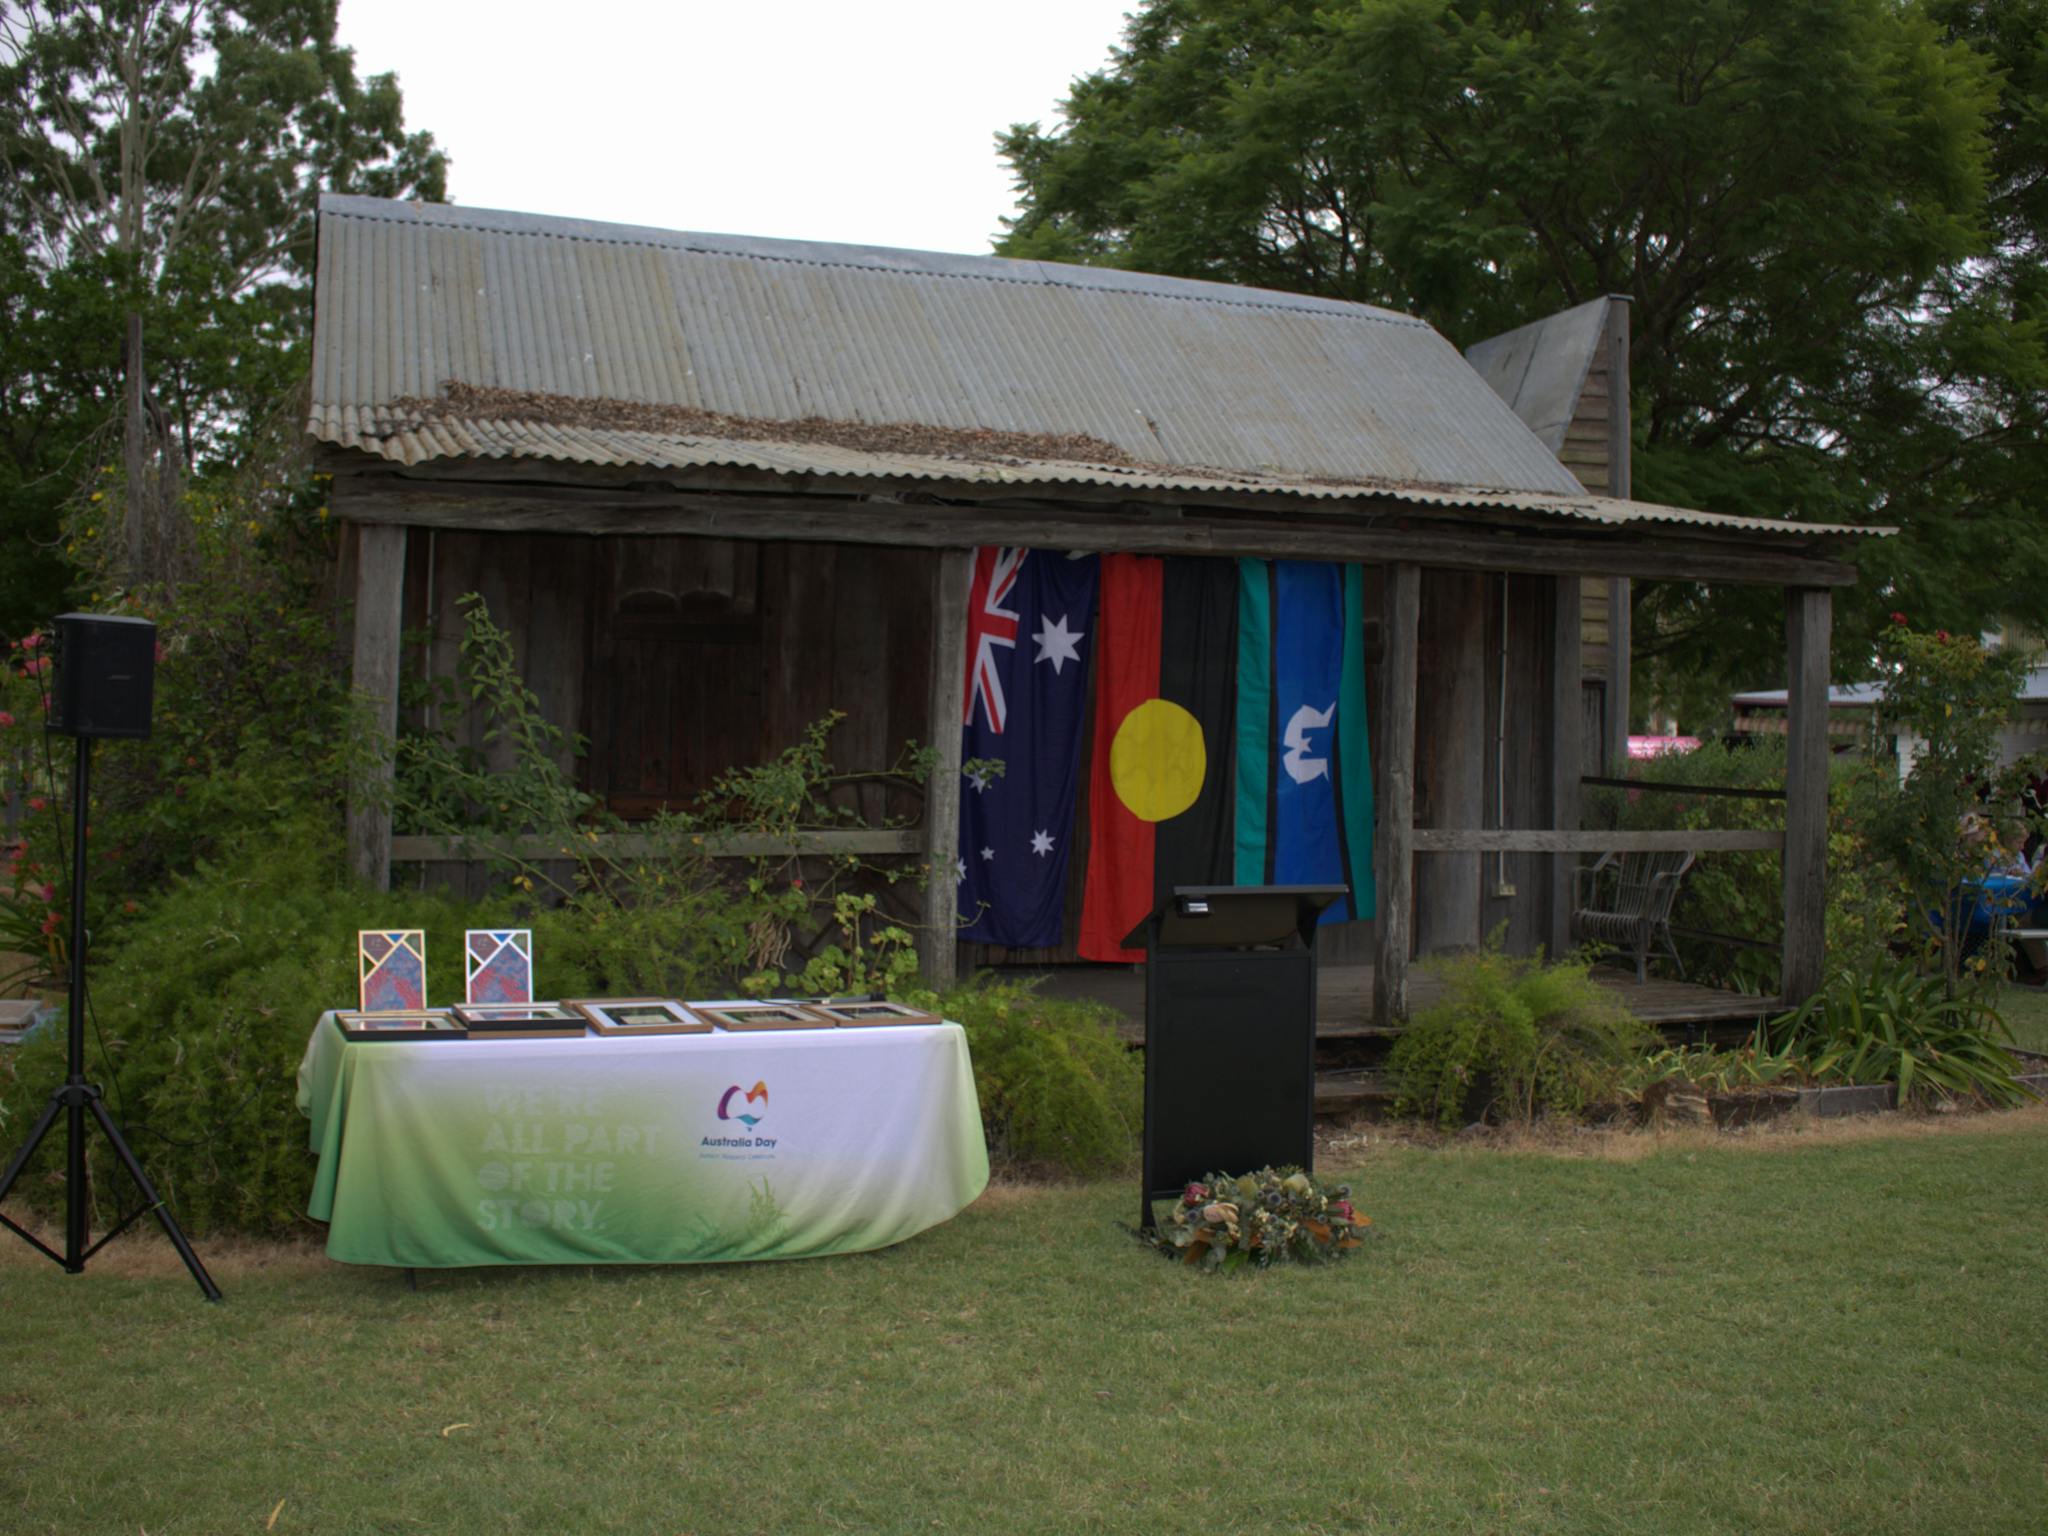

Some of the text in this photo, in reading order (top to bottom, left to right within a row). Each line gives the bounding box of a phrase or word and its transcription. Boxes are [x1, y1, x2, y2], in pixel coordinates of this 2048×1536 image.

[481, 1121, 660, 1154] ALL PART
[701, 1136, 777, 1149] Australia Day
[543, 1161, 616, 1193] THE
